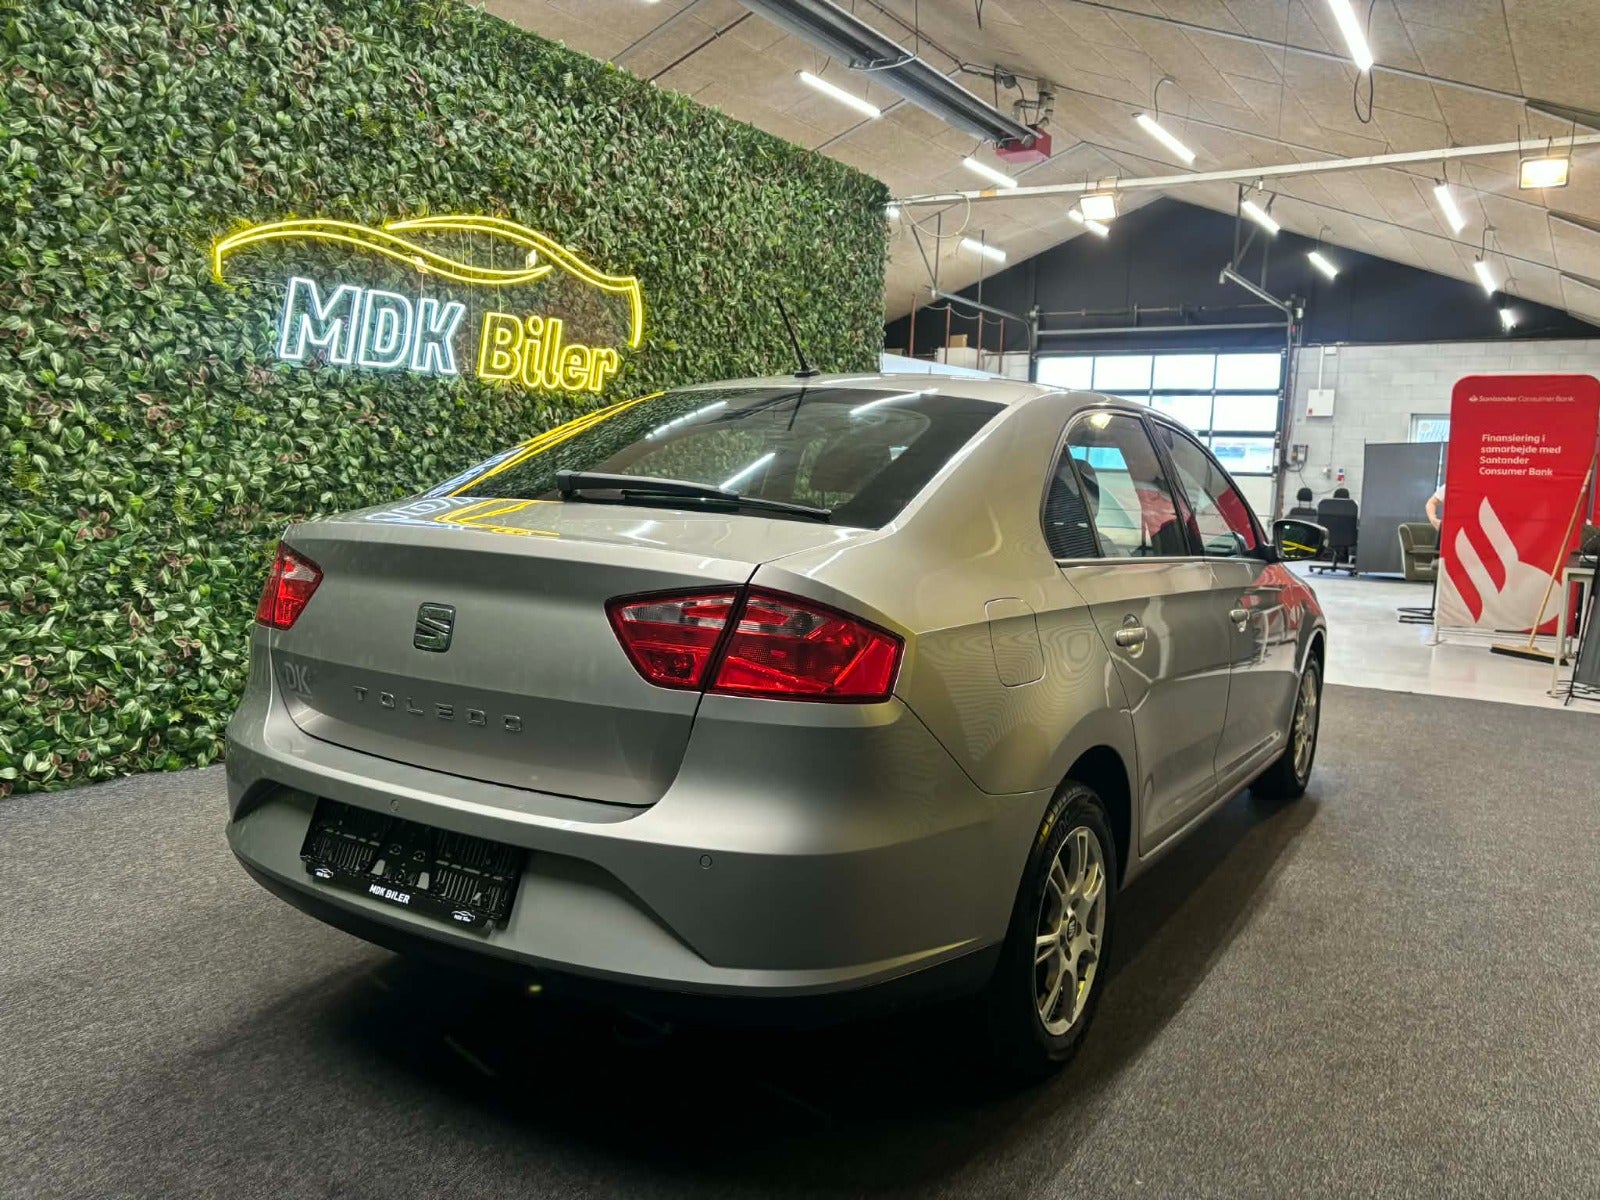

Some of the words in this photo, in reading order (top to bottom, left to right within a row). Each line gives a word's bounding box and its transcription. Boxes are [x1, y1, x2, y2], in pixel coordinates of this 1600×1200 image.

[278, 276, 466, 376] MDK
[478, 310, 618, 392] Biler
[1481, 433, 1540, 444] Finansiering
[1480, 445, 1538, 455] samarbejde
[1539, 446, 1562, 454] med
[1479, 456, 1530, 465] Santander
[1479, 467, 1527, 476] Consumer
[1528, 467, 1553, 476] Bank
[353, 685, 523, 732] TOLEDO
[369, 883, 387, 897] MDK
[385, 889, 411, 905] BILER
